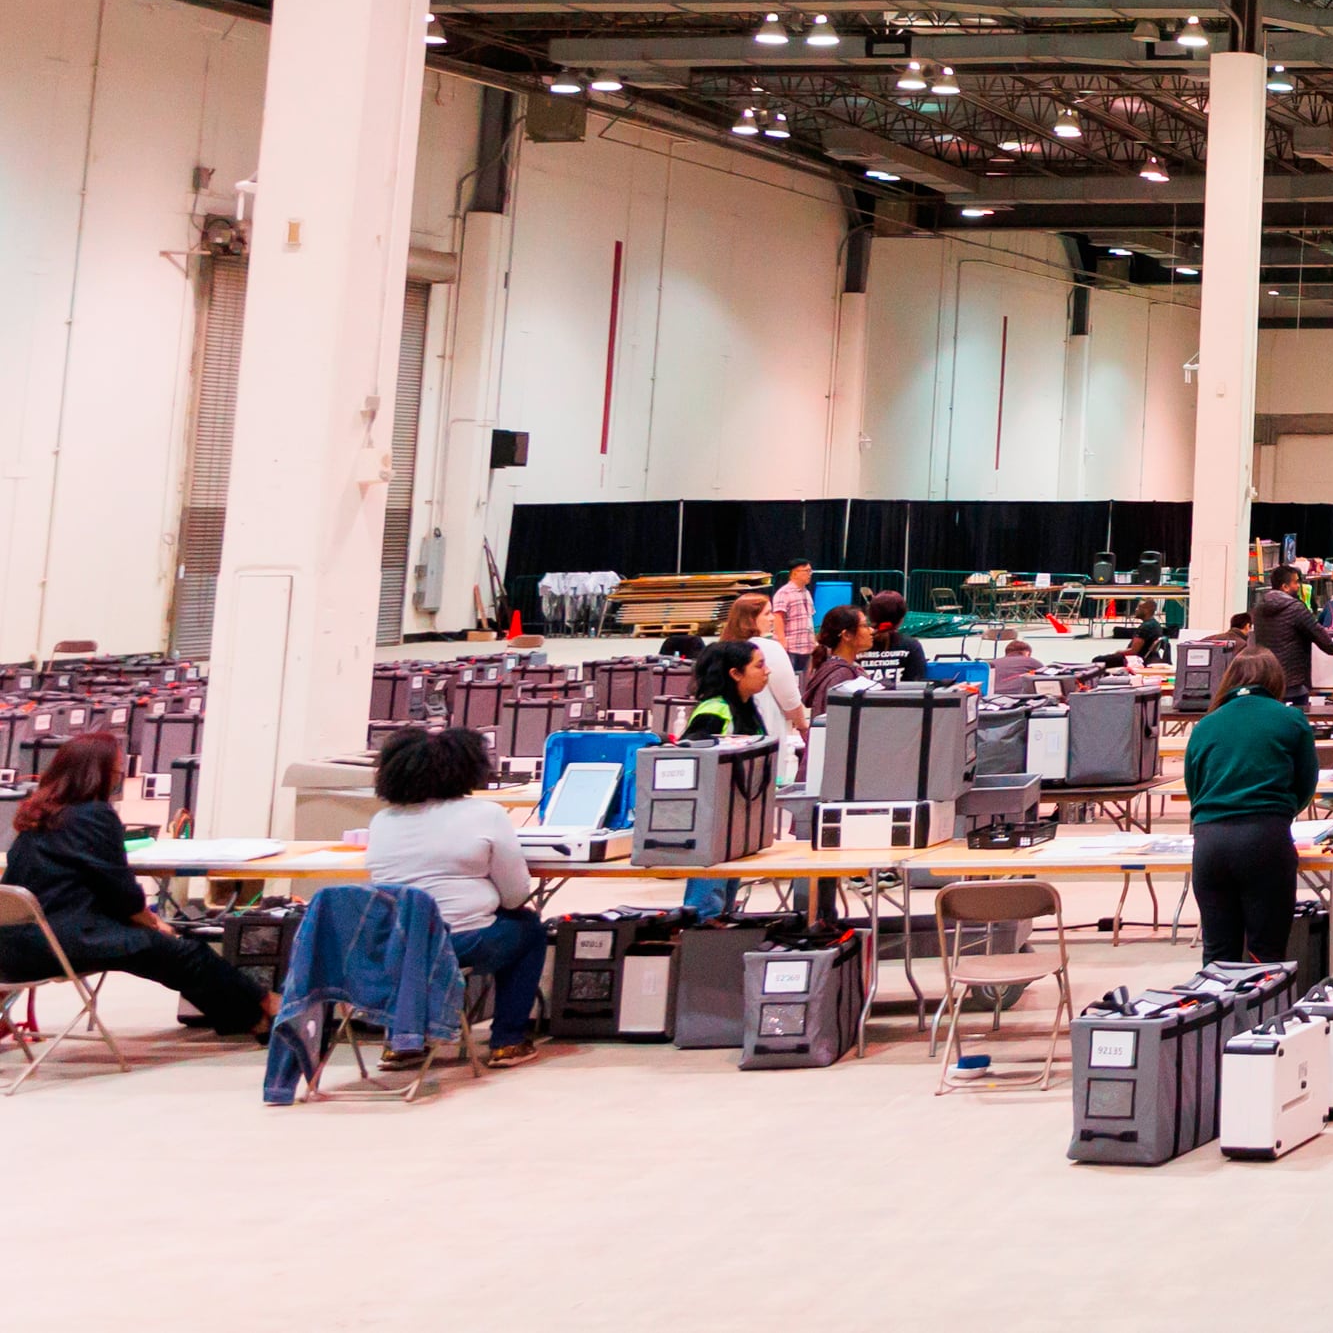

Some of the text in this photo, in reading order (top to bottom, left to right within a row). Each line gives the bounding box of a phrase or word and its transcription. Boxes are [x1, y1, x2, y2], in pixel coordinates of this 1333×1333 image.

[881, 650, 910, 658] COUNTY
[860, 659, 901, 667] ELECTIONS
[1097, 1045, 1123, 1056] 92135
